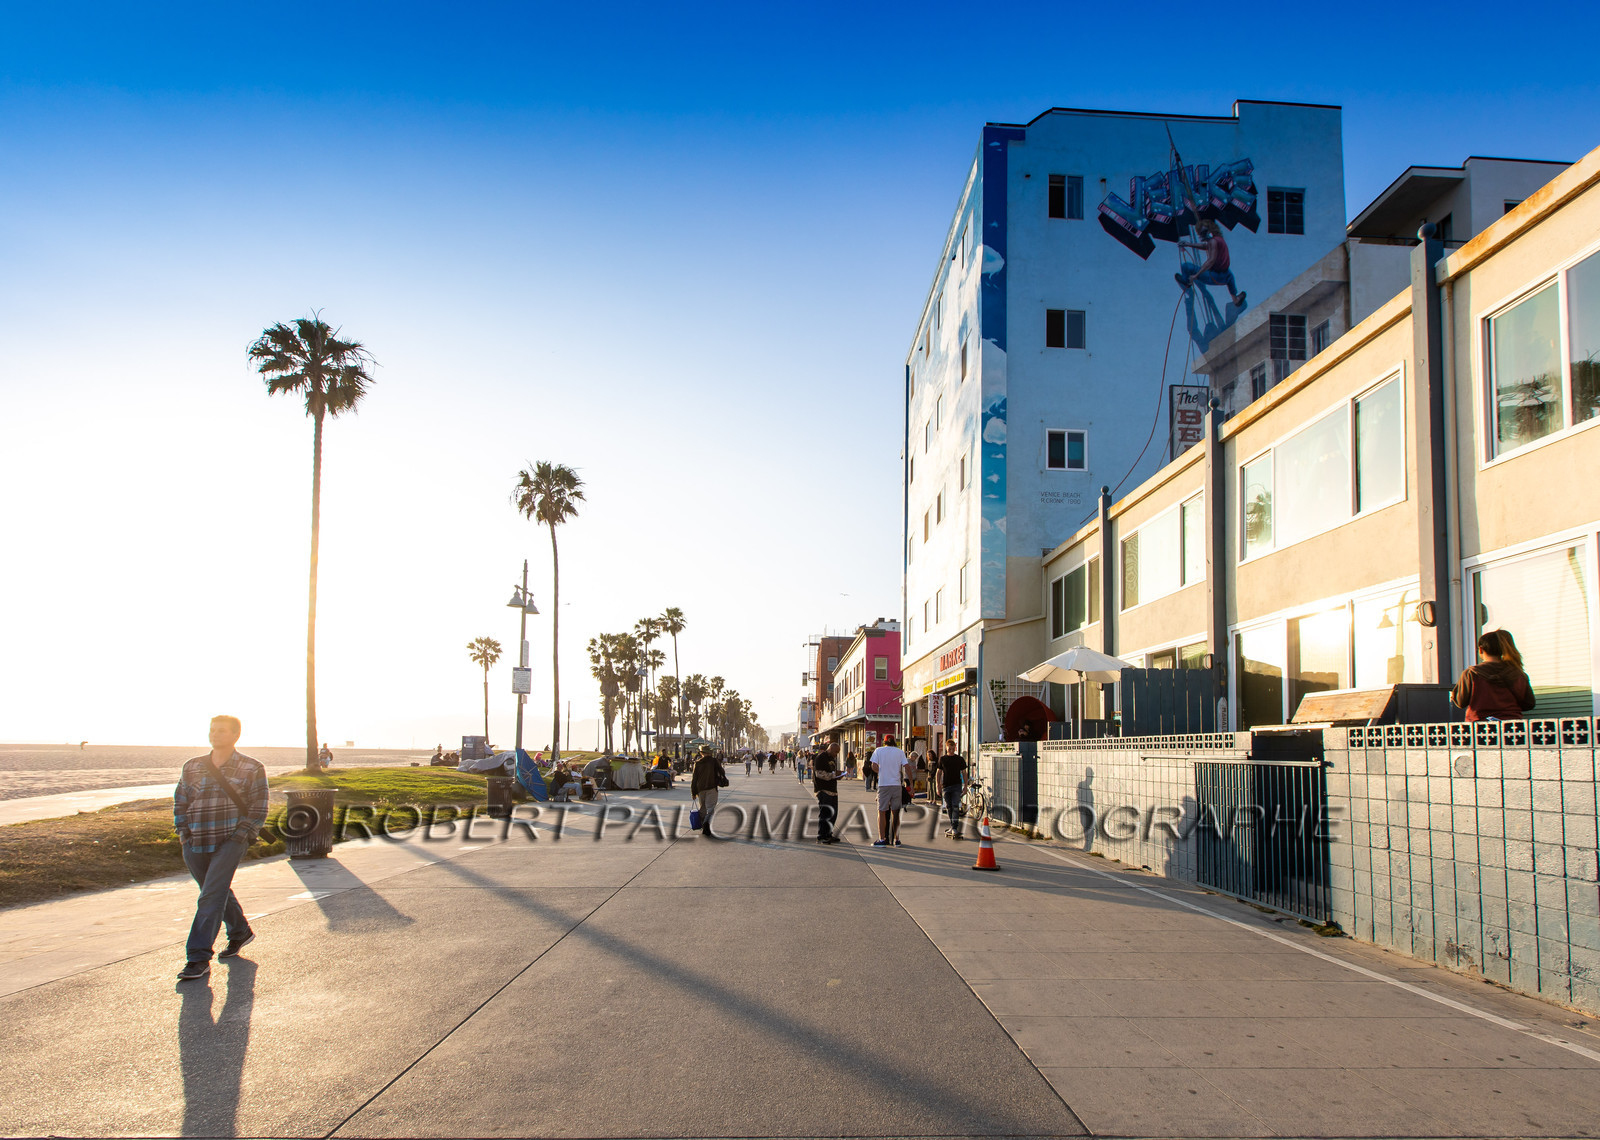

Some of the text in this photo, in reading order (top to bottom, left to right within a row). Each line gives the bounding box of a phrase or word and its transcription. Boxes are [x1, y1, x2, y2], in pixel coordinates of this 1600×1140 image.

[1097, 158, 1258, 239] VENICE
[1177, 389, 1199, 405] The
[940, 643, 967, 672] MARKET
